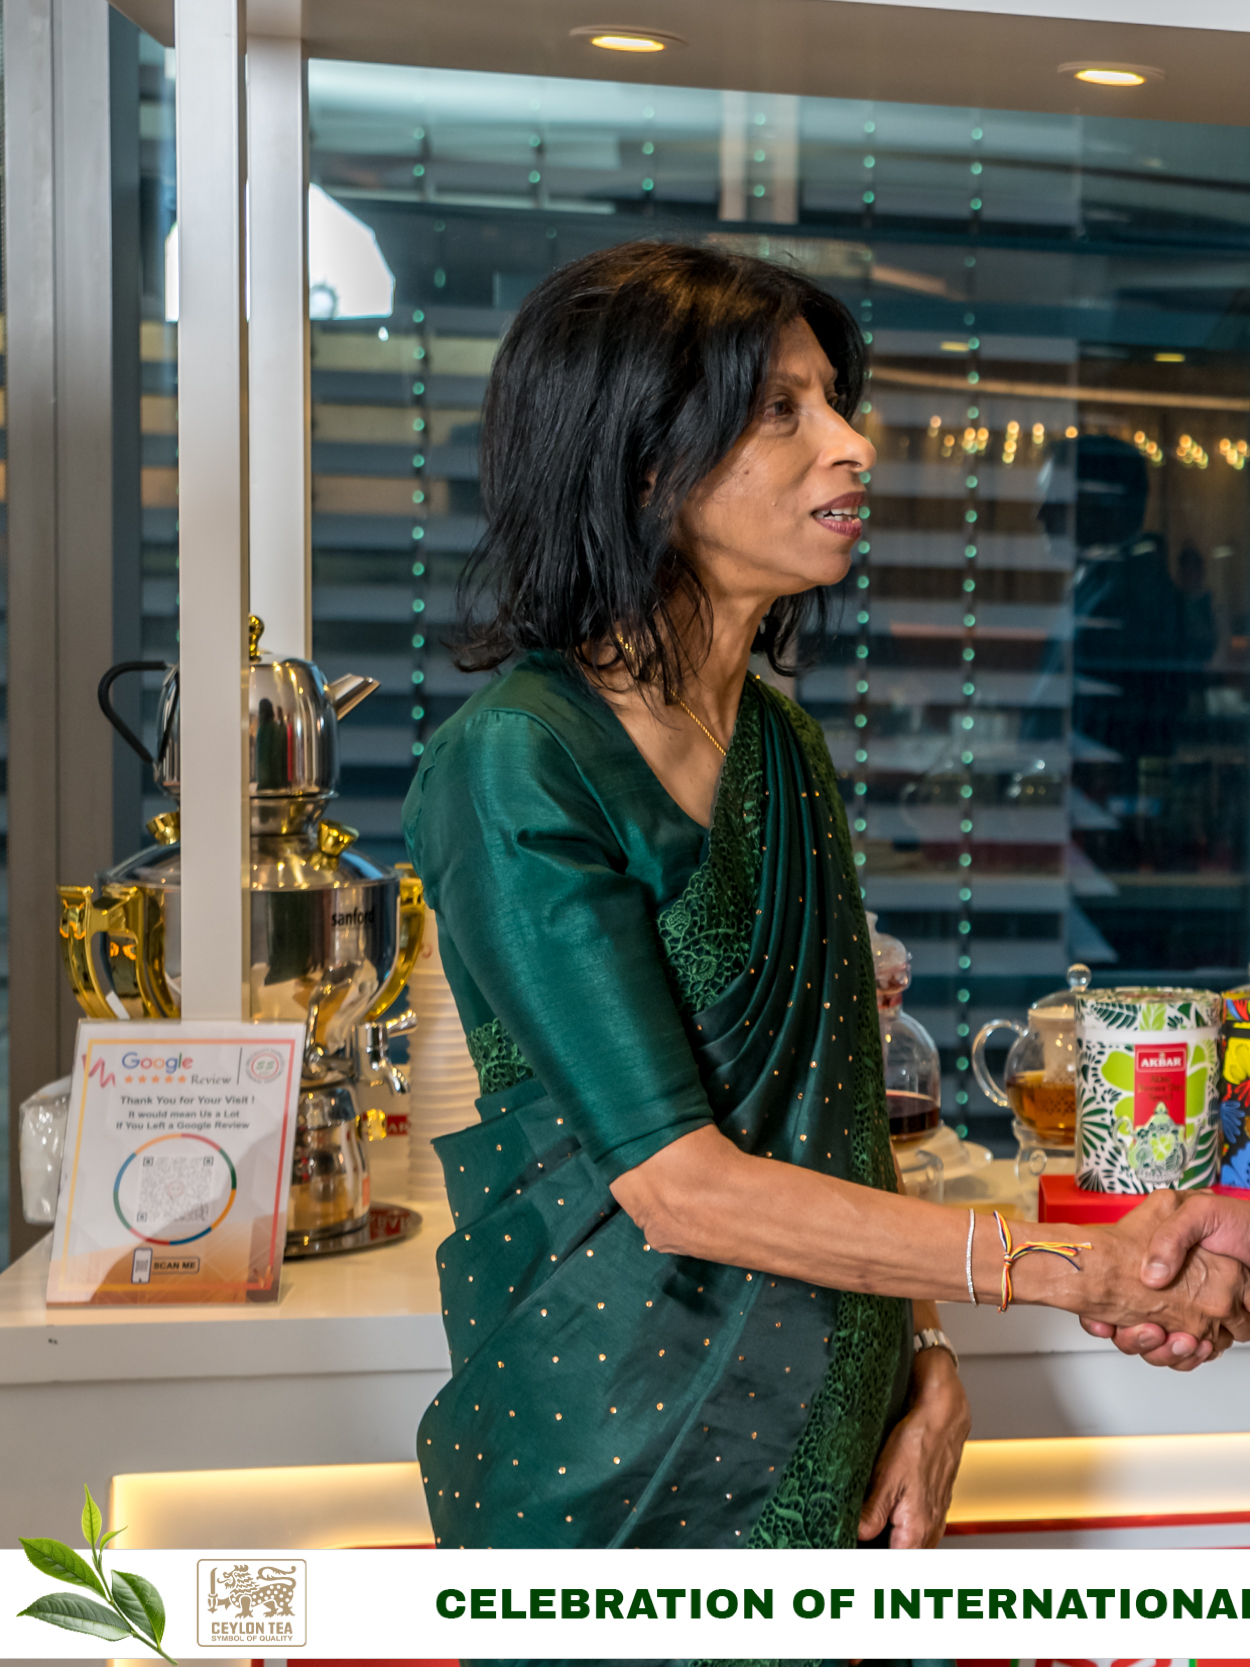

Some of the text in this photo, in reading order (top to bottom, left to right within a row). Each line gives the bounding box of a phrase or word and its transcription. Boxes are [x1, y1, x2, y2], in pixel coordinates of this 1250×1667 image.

[332, 907, 375, 927] sanford
[121, 1051, 194, 1074] Google
[1141, 1057, 1182, 1068] AKBAR
[190, 1073, 232, 1085] Review
[121, 1096, 153, 1105] Thank
[156, 1096, 176, 1105] You
[179, 1096, 194, 1105] for
[198, 1096, 221, 1105] Your
[225, 1096, 248, 1105] Visit
[224, 1110, 240, 1118] Lot
[126, 1122, 144, 1130] You
[147, 1122, 165, 1130] Left
[177, 1122, 212, 1131] Google
[214, 1122, 250, 1130] Review
[154, 1262, 180, 1270] SCAN
